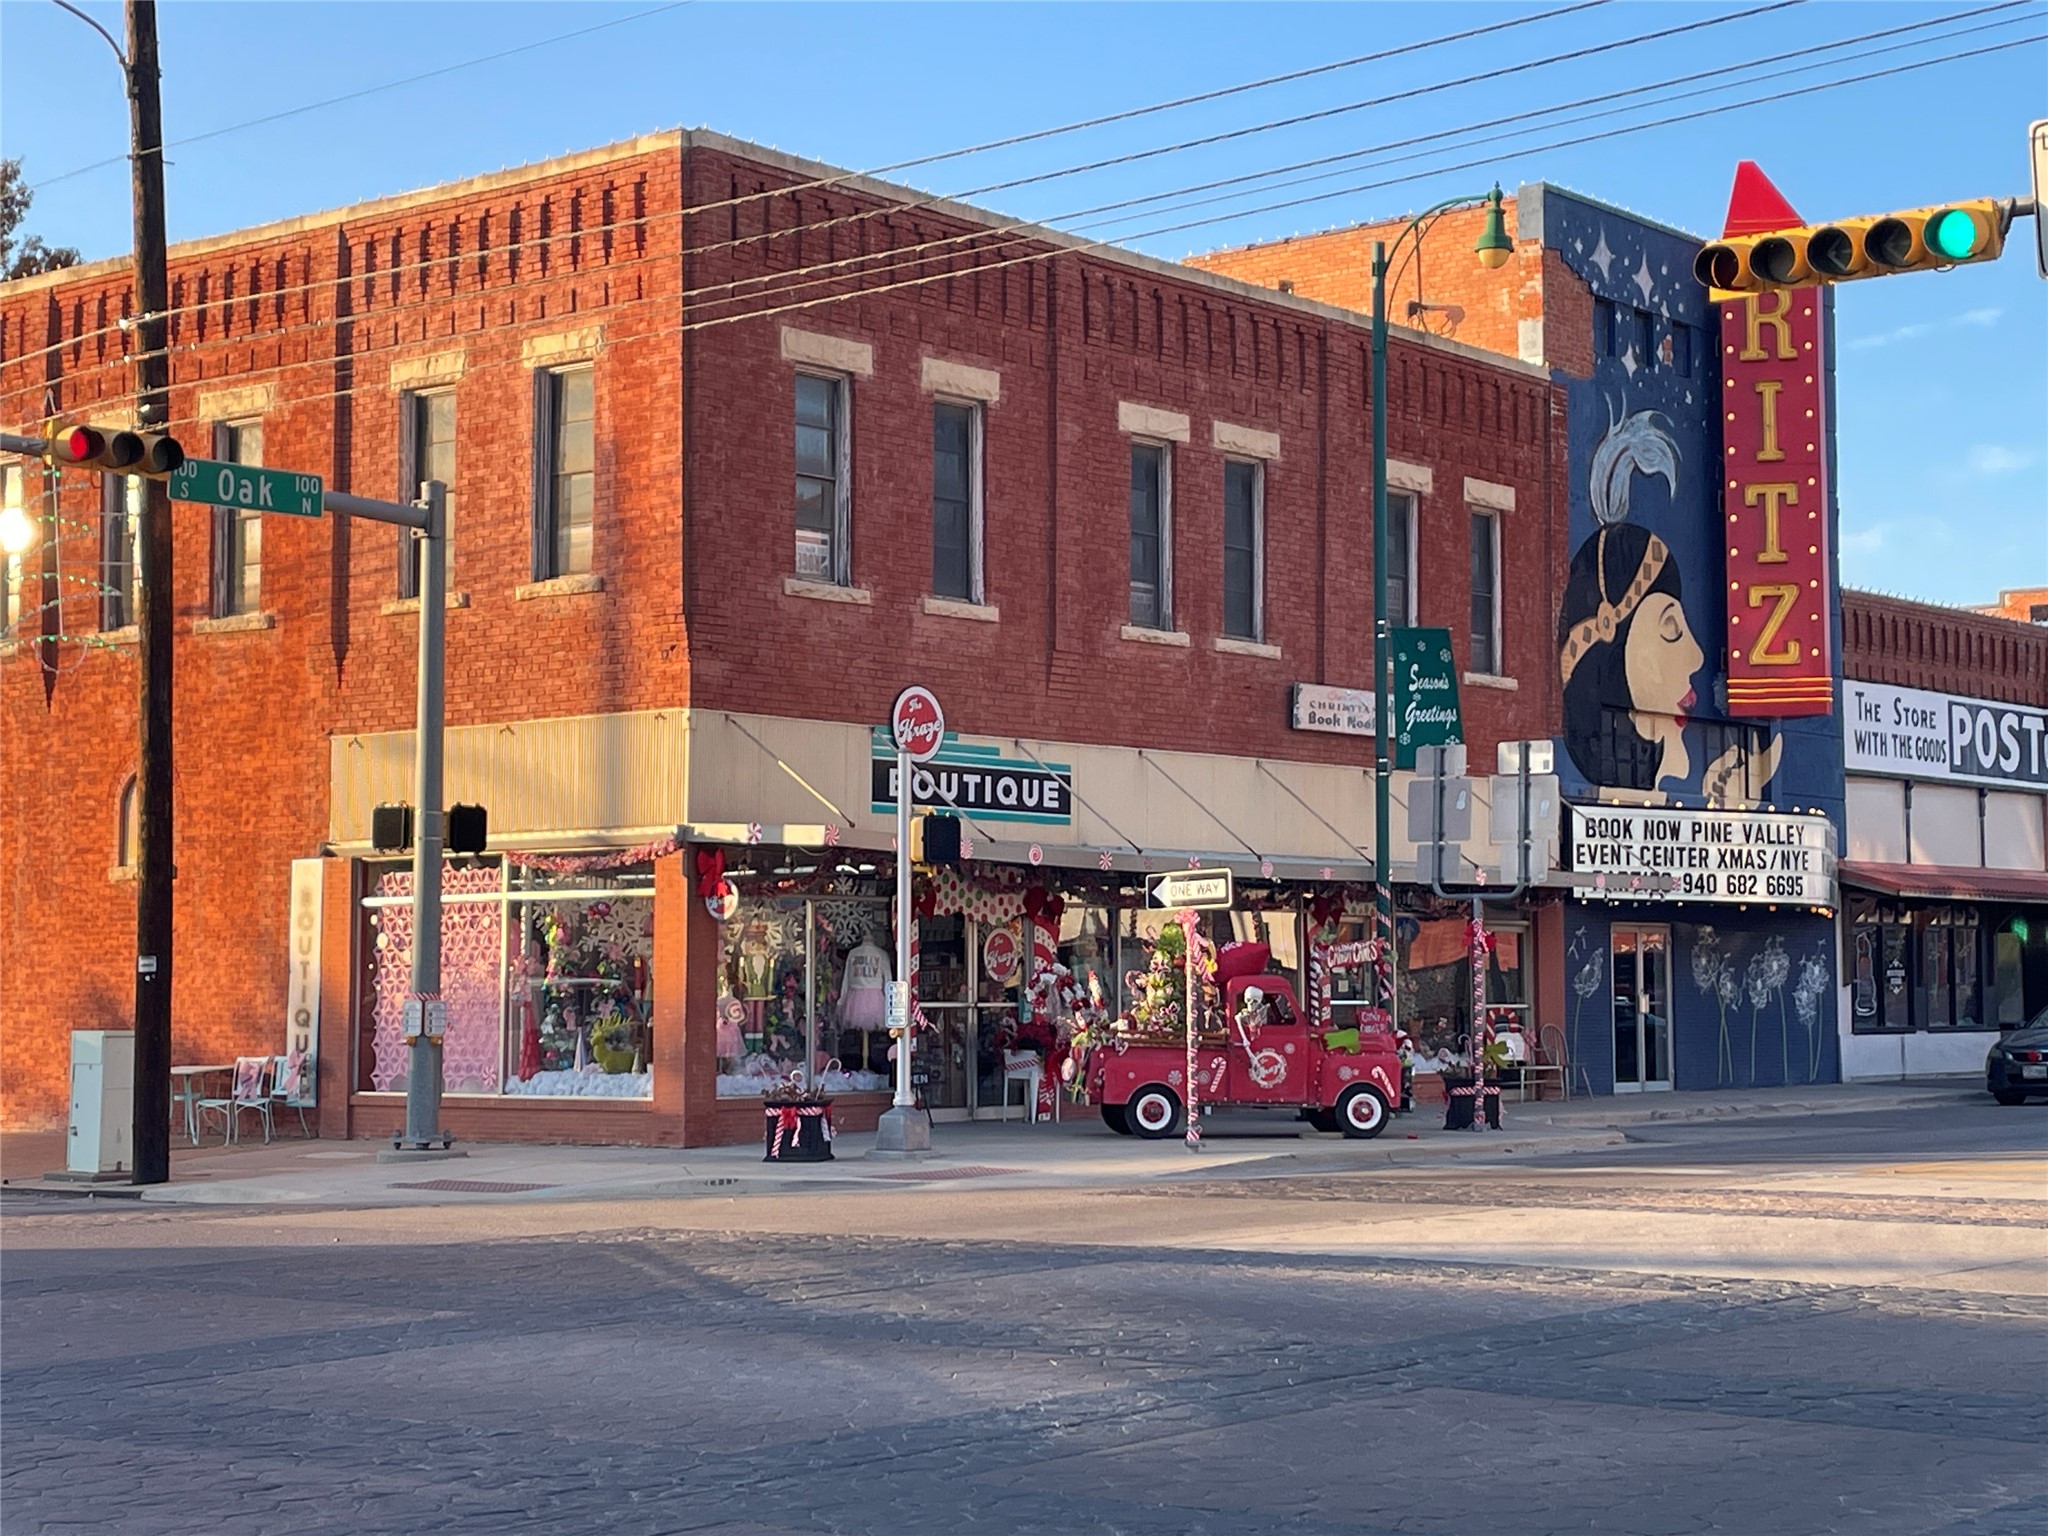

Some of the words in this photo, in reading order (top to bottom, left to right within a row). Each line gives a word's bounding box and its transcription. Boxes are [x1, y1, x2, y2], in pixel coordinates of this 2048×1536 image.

[180, 481, 189, 498] S
[218, 468, 273, 507] Oak
[295, 475, 319, 494] 100
[1739, 288, 1802, 666] RITZ
[302, 497, 312, 514] N
[1408, 663, 1450, 692] Season's
[909, 698, 922, 712] The
[1308, 711, 1341, 727] Book
[1405, 701, 1458, 731] Greetings
[1854, 729, 1888, 757] WITH
[1891, 733, 1914, 760] THE
[1915, 736, 1947, 764] GOODS
[1951, 704, 2048, 775] POST
[1585, 817, 1633, 840] BOOK
[1643, 819, 1681, 842] NOW
[1691, 822, 1733, 843] PINE
[1743, 823, 1805, 845] VALLEY
[1576, 843, 1633, 866] EVENT
[1640, 845, 1709, 868] CENTER
[1717, 848, 1809, 871] XMAS/NYE
[1170, 883, 1192, 897] ONE
[1196, 881, 1220, 895] WAY
[1683, 873, 1717, 895] 940
[1726, 874, 1757, 896] 682
[1766, 875, 1803, 897] 6695
[295, 888, 314, 1072] BOUTIQU
